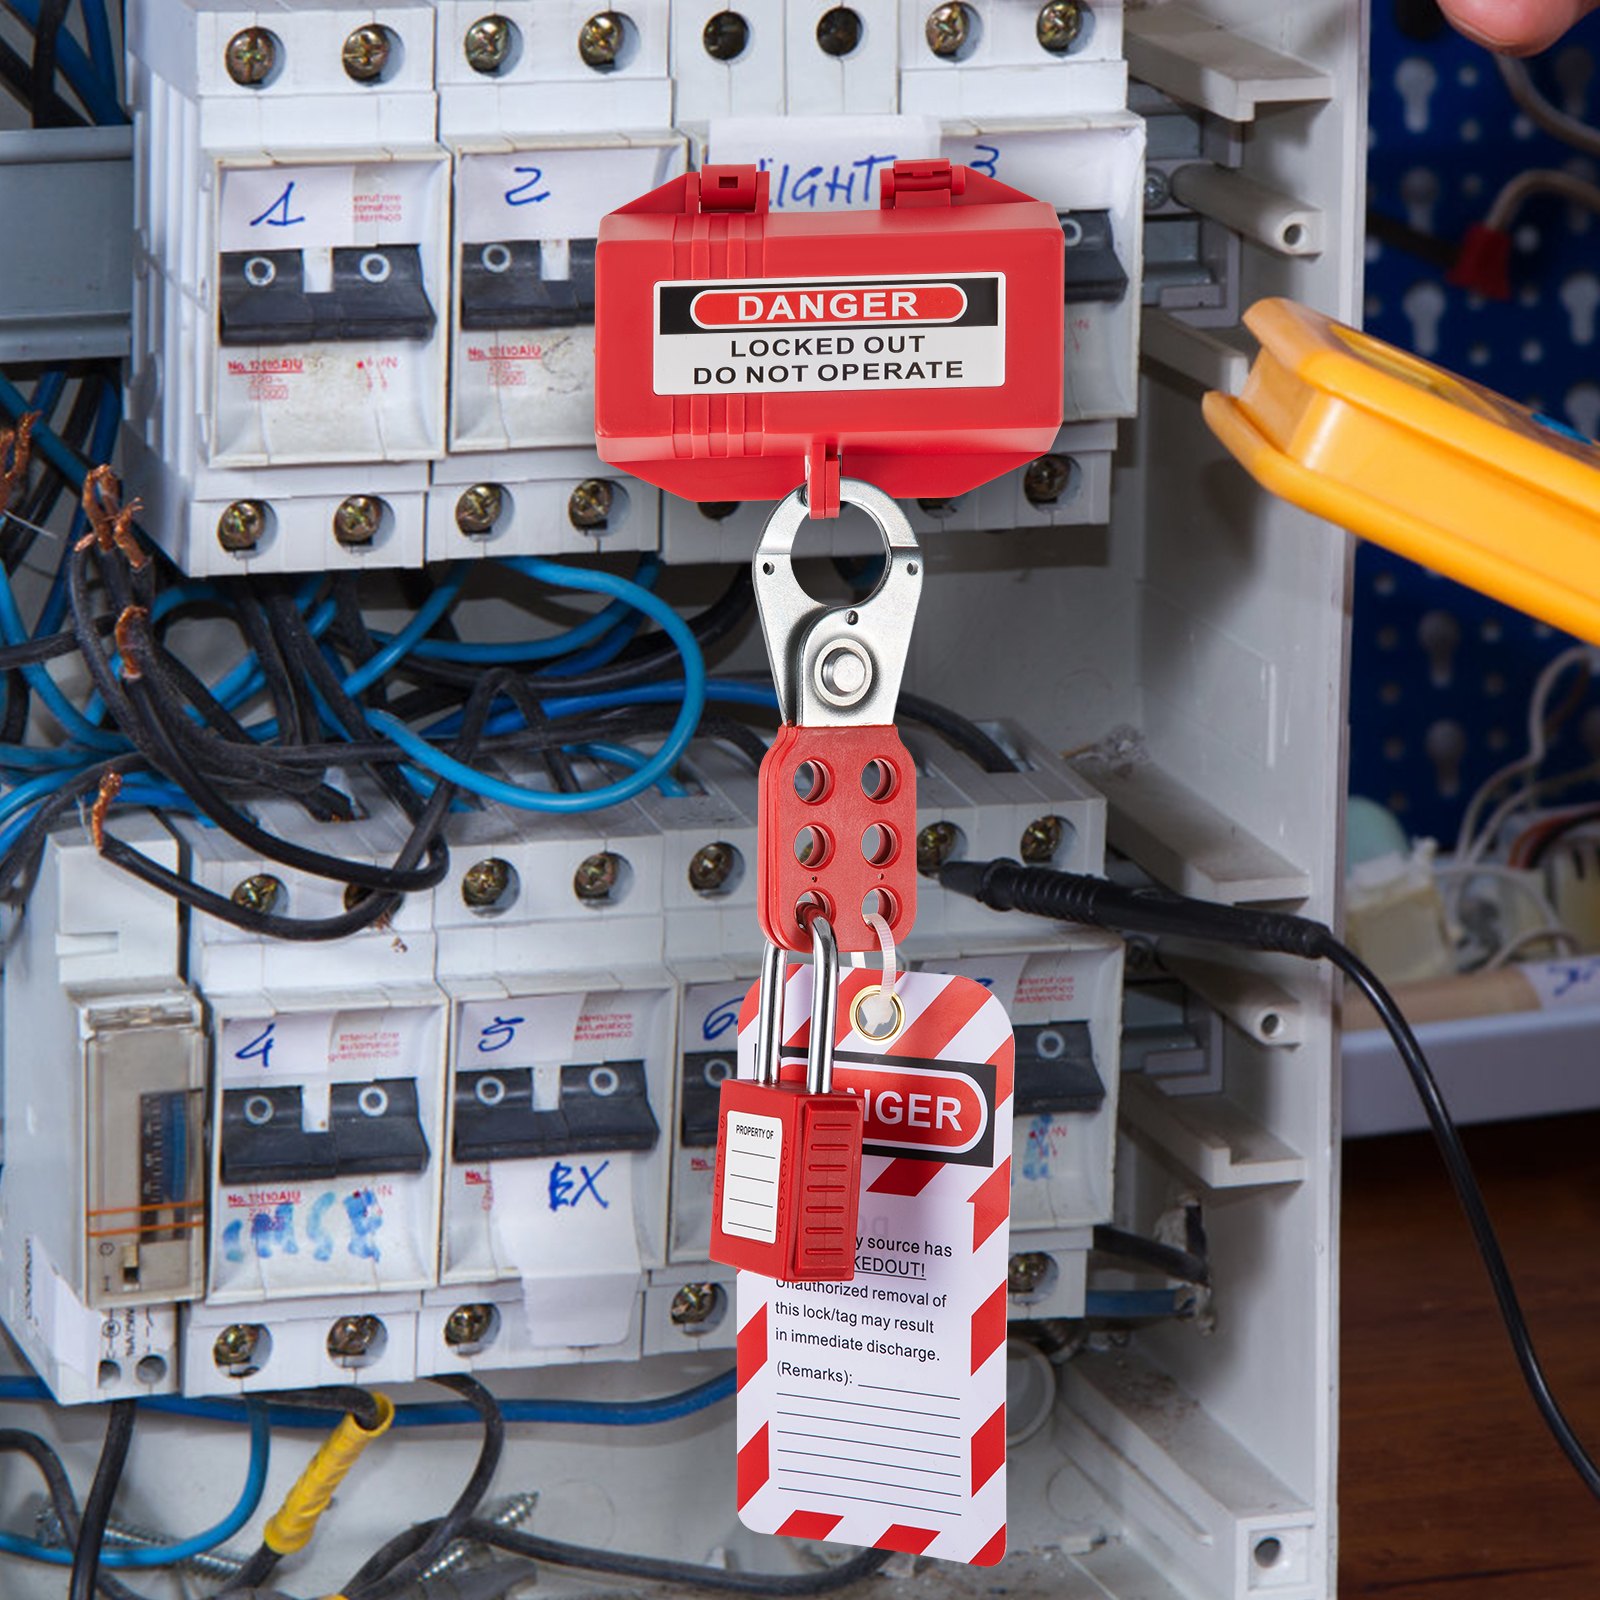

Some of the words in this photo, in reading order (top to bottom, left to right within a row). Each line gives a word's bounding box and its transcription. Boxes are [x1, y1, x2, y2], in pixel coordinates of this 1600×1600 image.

[505, 167, 551, 206] 2
[760, 155, 898, 208] IGHT
[250, 181, 305, 226] 1
[738, 291, 919, 321] DANGER
[731, 337, 855, 358] LOCKED
[864, 335, 926, 355] OUT
[693, 366, 737, 385] DO
[746, 364, 809, 384] NOT
[818, 360, 964, 382] OPERATE
[235, 1022, 276, 1068] 4
[478, 1016, 526, 1053] 5
[735, 1124, 766, 1139] PROPERTY
[766, 1130, 775, 1140] OF
[867, 1237, 920, 1254] source
[924, 1240, 953, 1258] has
[872, 1288, 929, 1306] removal
[932, 1294, 947, 1308] of
[775, 1301, 800, 1317] this
[803, 1304, 858, 1326] lock/tag
[861, 1313, 891, 1330] may
[894, 1318, 935, 1334] result
[775, 1327, 788, 1341] in
[791, 1329, 863, 1351] immediate
[866, 1339, 941, 1363] discharge.
[777, 1360, 853, 1386] (Remarks):
